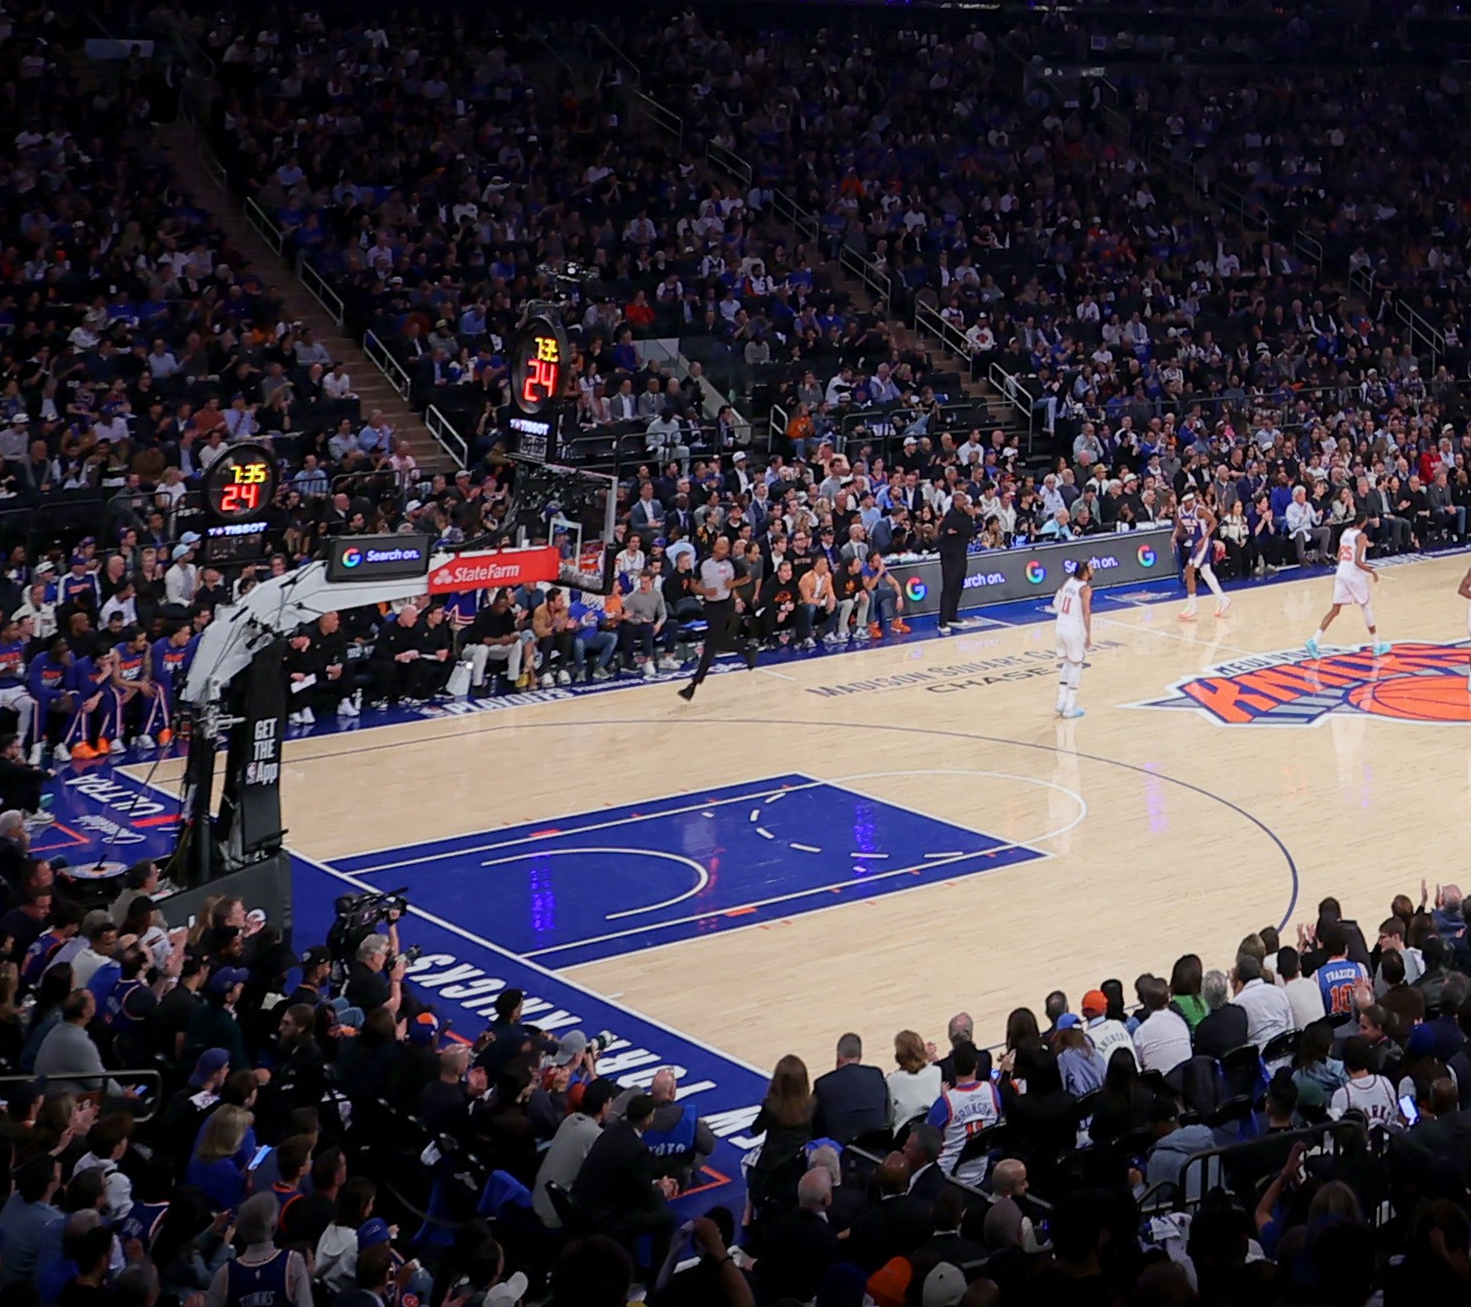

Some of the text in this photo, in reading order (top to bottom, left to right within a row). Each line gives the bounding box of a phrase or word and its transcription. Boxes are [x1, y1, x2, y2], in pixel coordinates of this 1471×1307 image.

[524, 360, 558, 401] 24
[519, 419, 551, 435] TISSOT
[230, 463, 267, 484] 7:35
[221, 484, 260, 511] 24
[224, 522, 268, 535] TISSOT
[366, 548, 420, 563] Search on.
[1102, 556, 1118, 568] on.
[1339, 546, 1352, 560] 25
[1062, 597, 1071, 615] 11
[805, 655, 1029, 698] MADISON SQUARE
[926, 666, 1058, 694] CHASE
[443, 687, 574, 715] PLAYOFFS
[254, 717, 277, 741] GET
[253, 740, 276, 761] THE
[257, 762, 278, 785] App
[64, 773, 165, 817] ULTRA
[1325, 968, 1356, 983] FRAZIER
[403, 953, 583, 1033] KNICKS
[955, 1102, 993, 1123] BRUNSON
